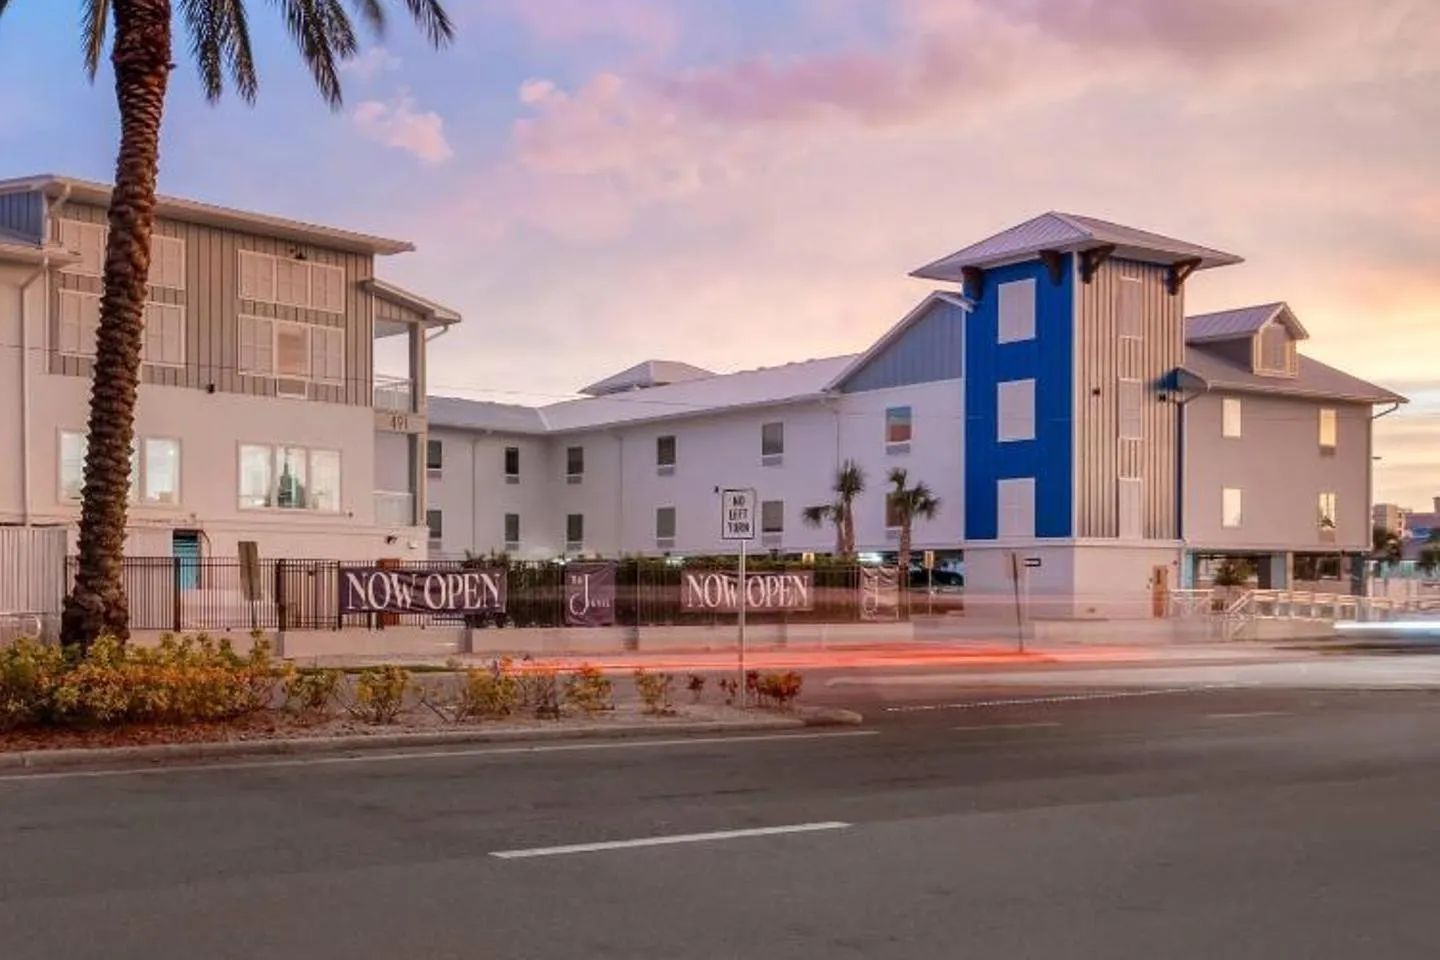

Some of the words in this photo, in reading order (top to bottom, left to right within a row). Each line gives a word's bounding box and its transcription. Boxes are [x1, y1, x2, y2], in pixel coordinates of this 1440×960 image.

[732, 495, 746, 507] NO
[728, 508, 748, 520] LEFT
[345, 571, 420, 610] NOW
[423, 572, 501, 610] OPEN
[686, 573, 740, 608] NOW
[746, 574, 809, 608] OPEN
